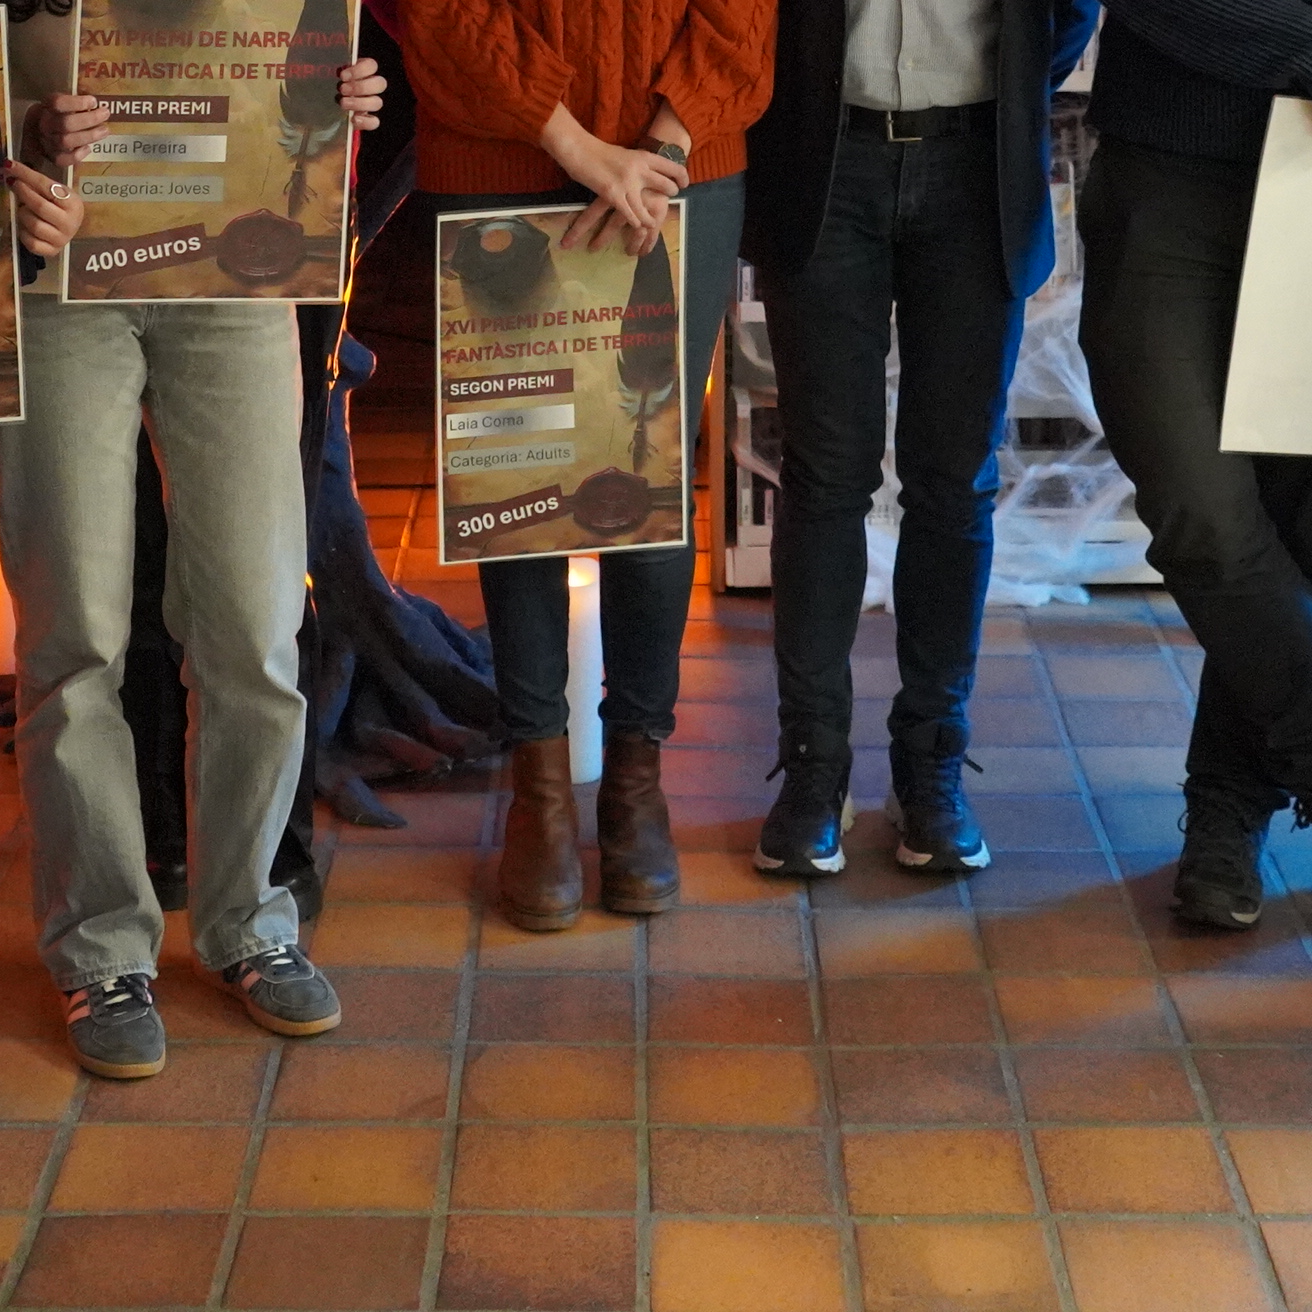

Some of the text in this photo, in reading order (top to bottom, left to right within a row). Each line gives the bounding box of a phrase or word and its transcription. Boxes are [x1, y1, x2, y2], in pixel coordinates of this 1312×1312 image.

[86, 29, 349, 49] XVI PREMI DE NARRATIVA
[84, 57, 215, 80] FANTÀSTICA
[218, 63, 225, 79] I
[230, 63, 259, 80] DE
[96, 100, 212, 115] RIMER PREMI
[90, 140, 187, 155] aura Pereira
[81, 181, 211, 197] Categoria: Joves
[85, 235, 202, 273] 400 euros
[445, 302, 675, 336] XVI PREMI DE NARRATIVA
[444, 340, 558, 364] FANTÀSTICA
[562, 339, 568, 354] I
[572, 337, 598, 353] DE
[450, 374, 555, 396] SEGON PREMI
[449, 414, 524, 432] Laia Coma
[450, 446, 571, 468] Categoria: Adults
[457, 495, 560, 538] 300 euros
